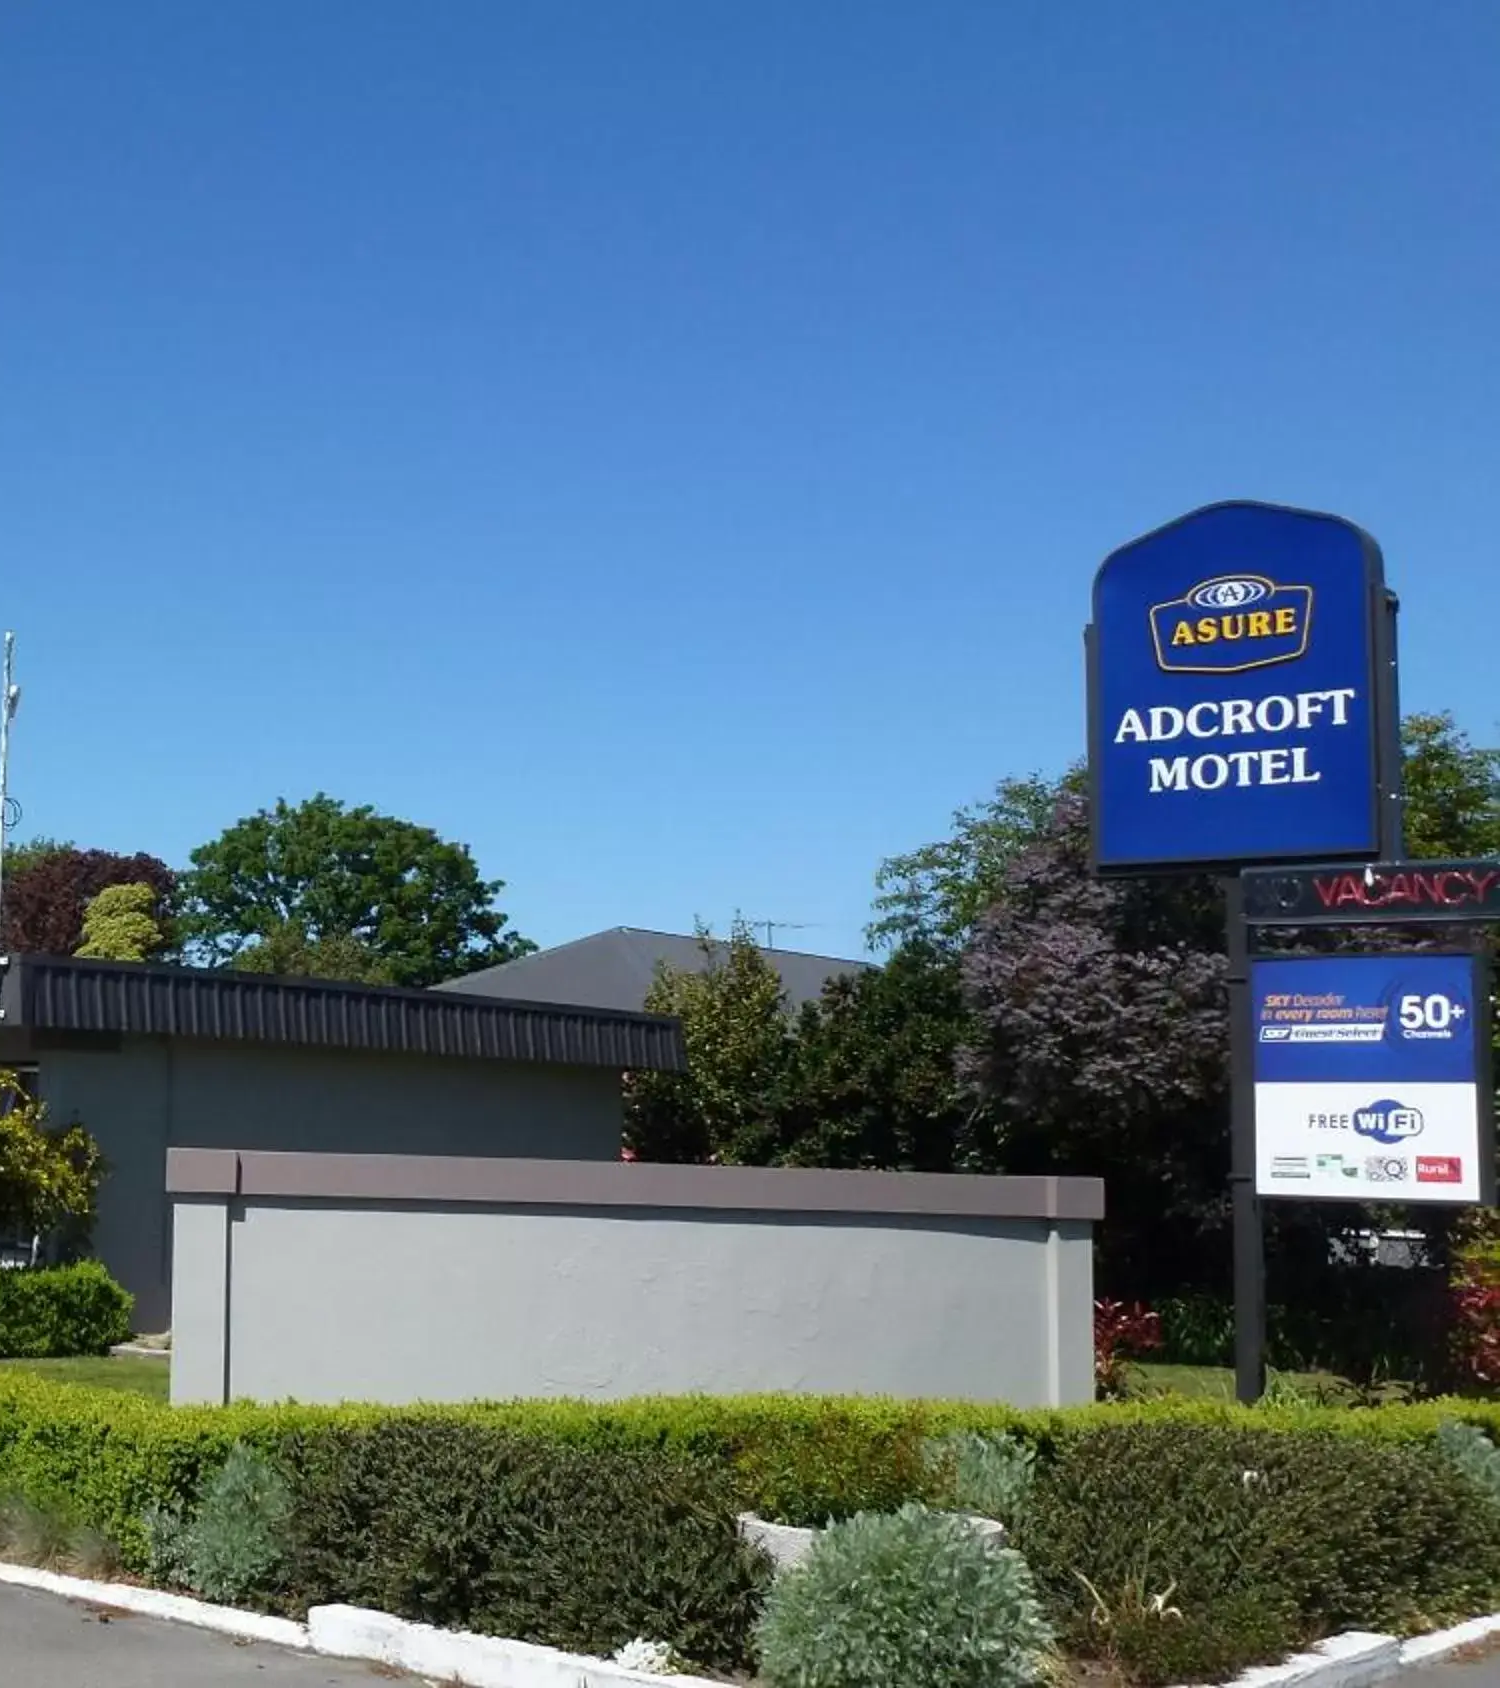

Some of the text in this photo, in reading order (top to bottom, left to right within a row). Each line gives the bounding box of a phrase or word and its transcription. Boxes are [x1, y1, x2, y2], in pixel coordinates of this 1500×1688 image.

[1171, 608, 1297, 646] ASURE
[1114, 688, 1355, 744] ADCROFT
[1149, 747, 1320, 793] MOTEL
[1313, 870, 1496, 906] VACANCY
[1264, 995, 1291, 1007] SKY
[1275, 1009, 1313, 1023] every
[1316, 1008, 1353, 1019] room
[1400, 994, 1465, 1029] 50+
[1403, 1029, 1452, 1039] Channels
[1308, 1114, 1349, 1129] FREE
